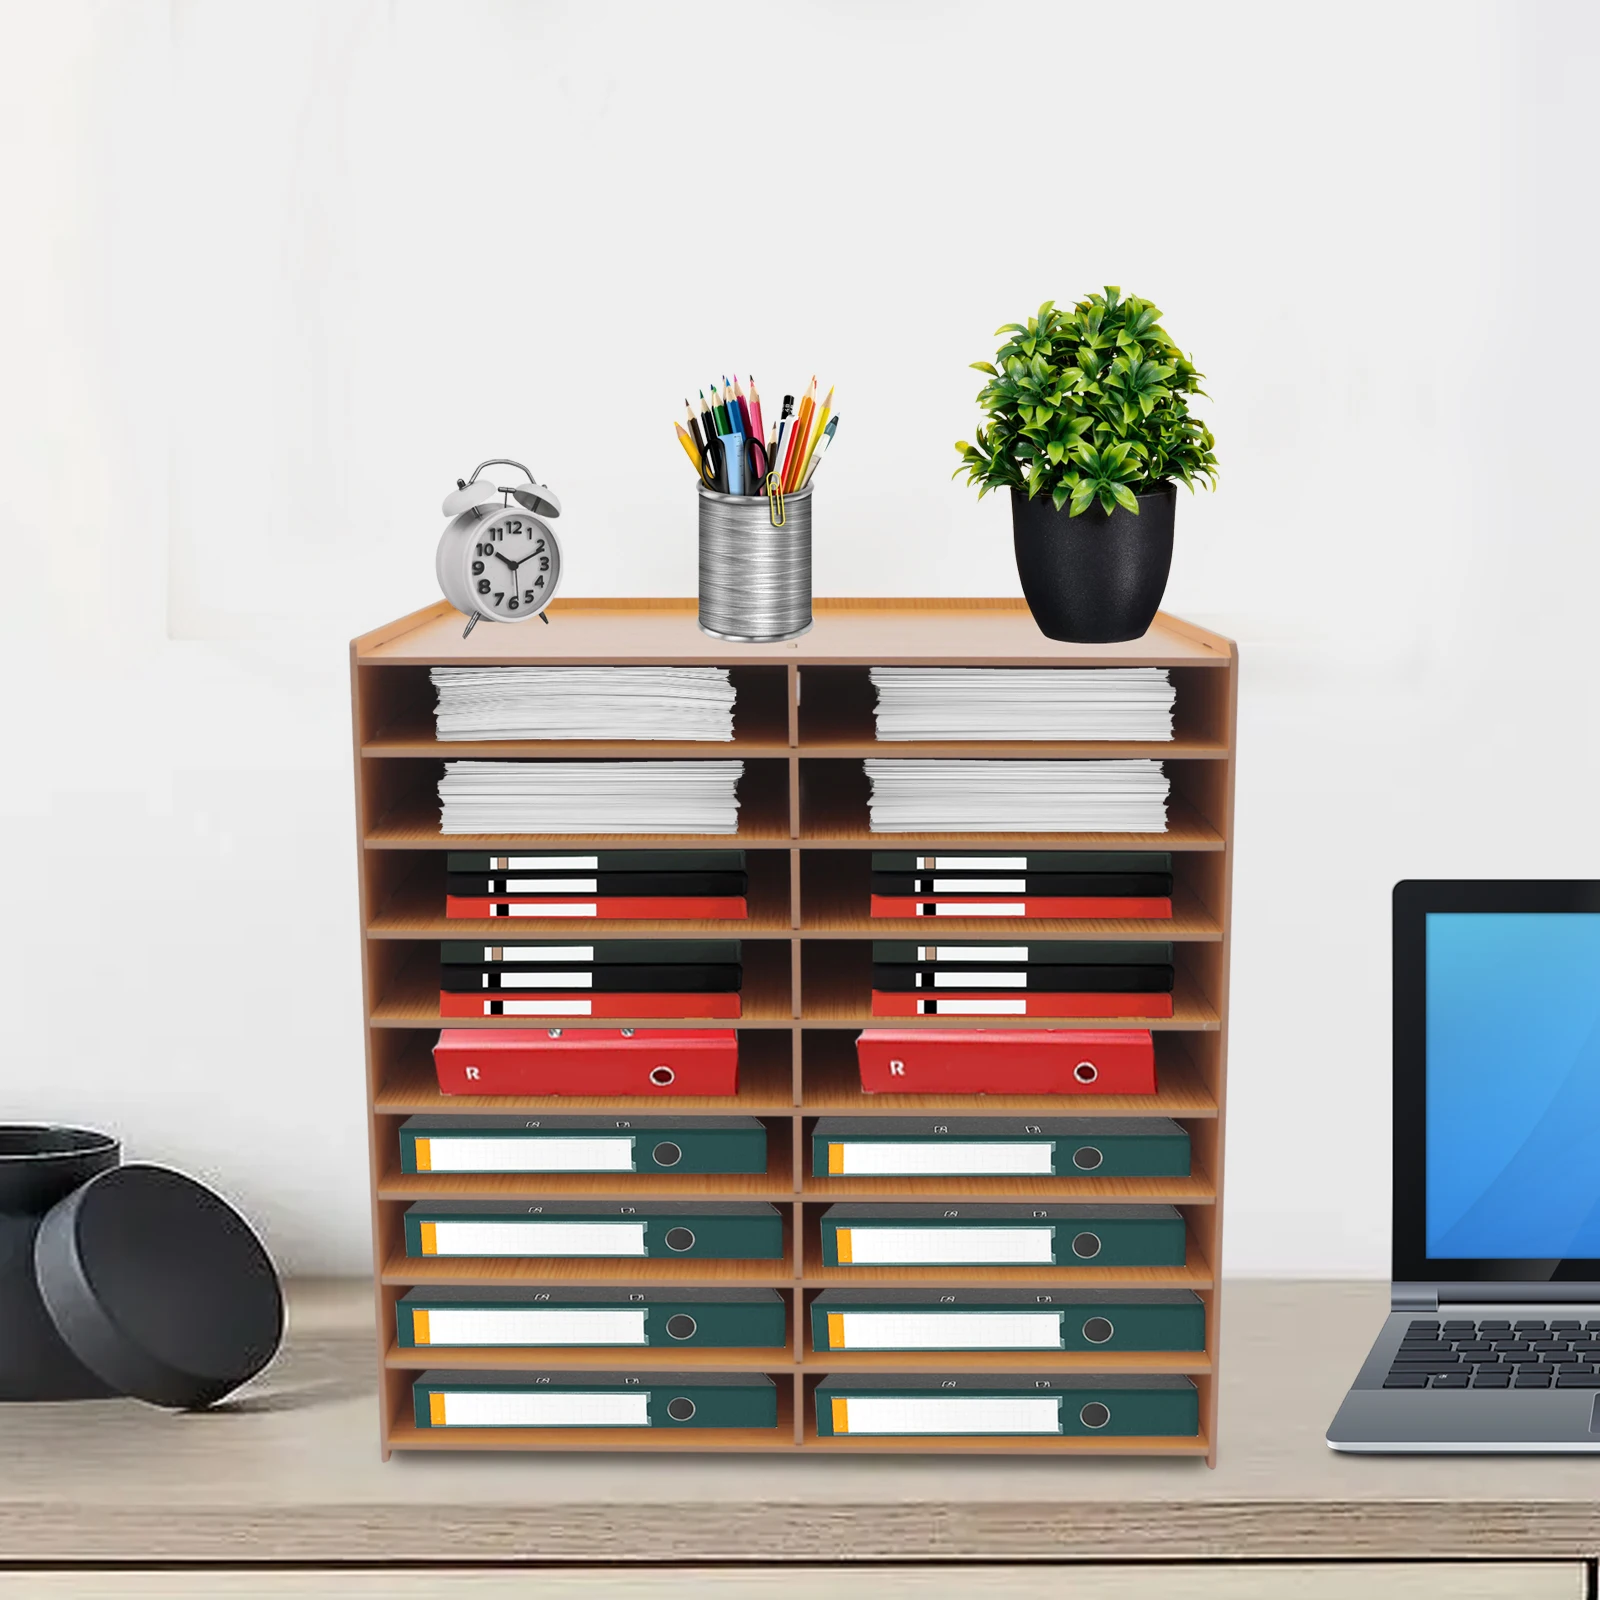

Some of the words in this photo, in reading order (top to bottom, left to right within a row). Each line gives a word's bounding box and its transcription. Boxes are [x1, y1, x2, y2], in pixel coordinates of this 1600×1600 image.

[489, 528, 503, 541] 11
[505, 521, 522, 534] 12
[527, 527, 532, 540] 1
[476, 543, 494, 557] 10
[536, 539, 545, 552] 2
[472, 561, 485, 576] 9
[540, 556, 549, 571] 3
[478, 579, 490, 594] 8
[534, 575, 545, 588] 4
[494, 592, 505, 606] 7
[508, 596, 519, 610] 6
[524, 590, 534, 604] 5
[466, 1066, 481, 1080] R
[890, 1060, 906, 1076] R
